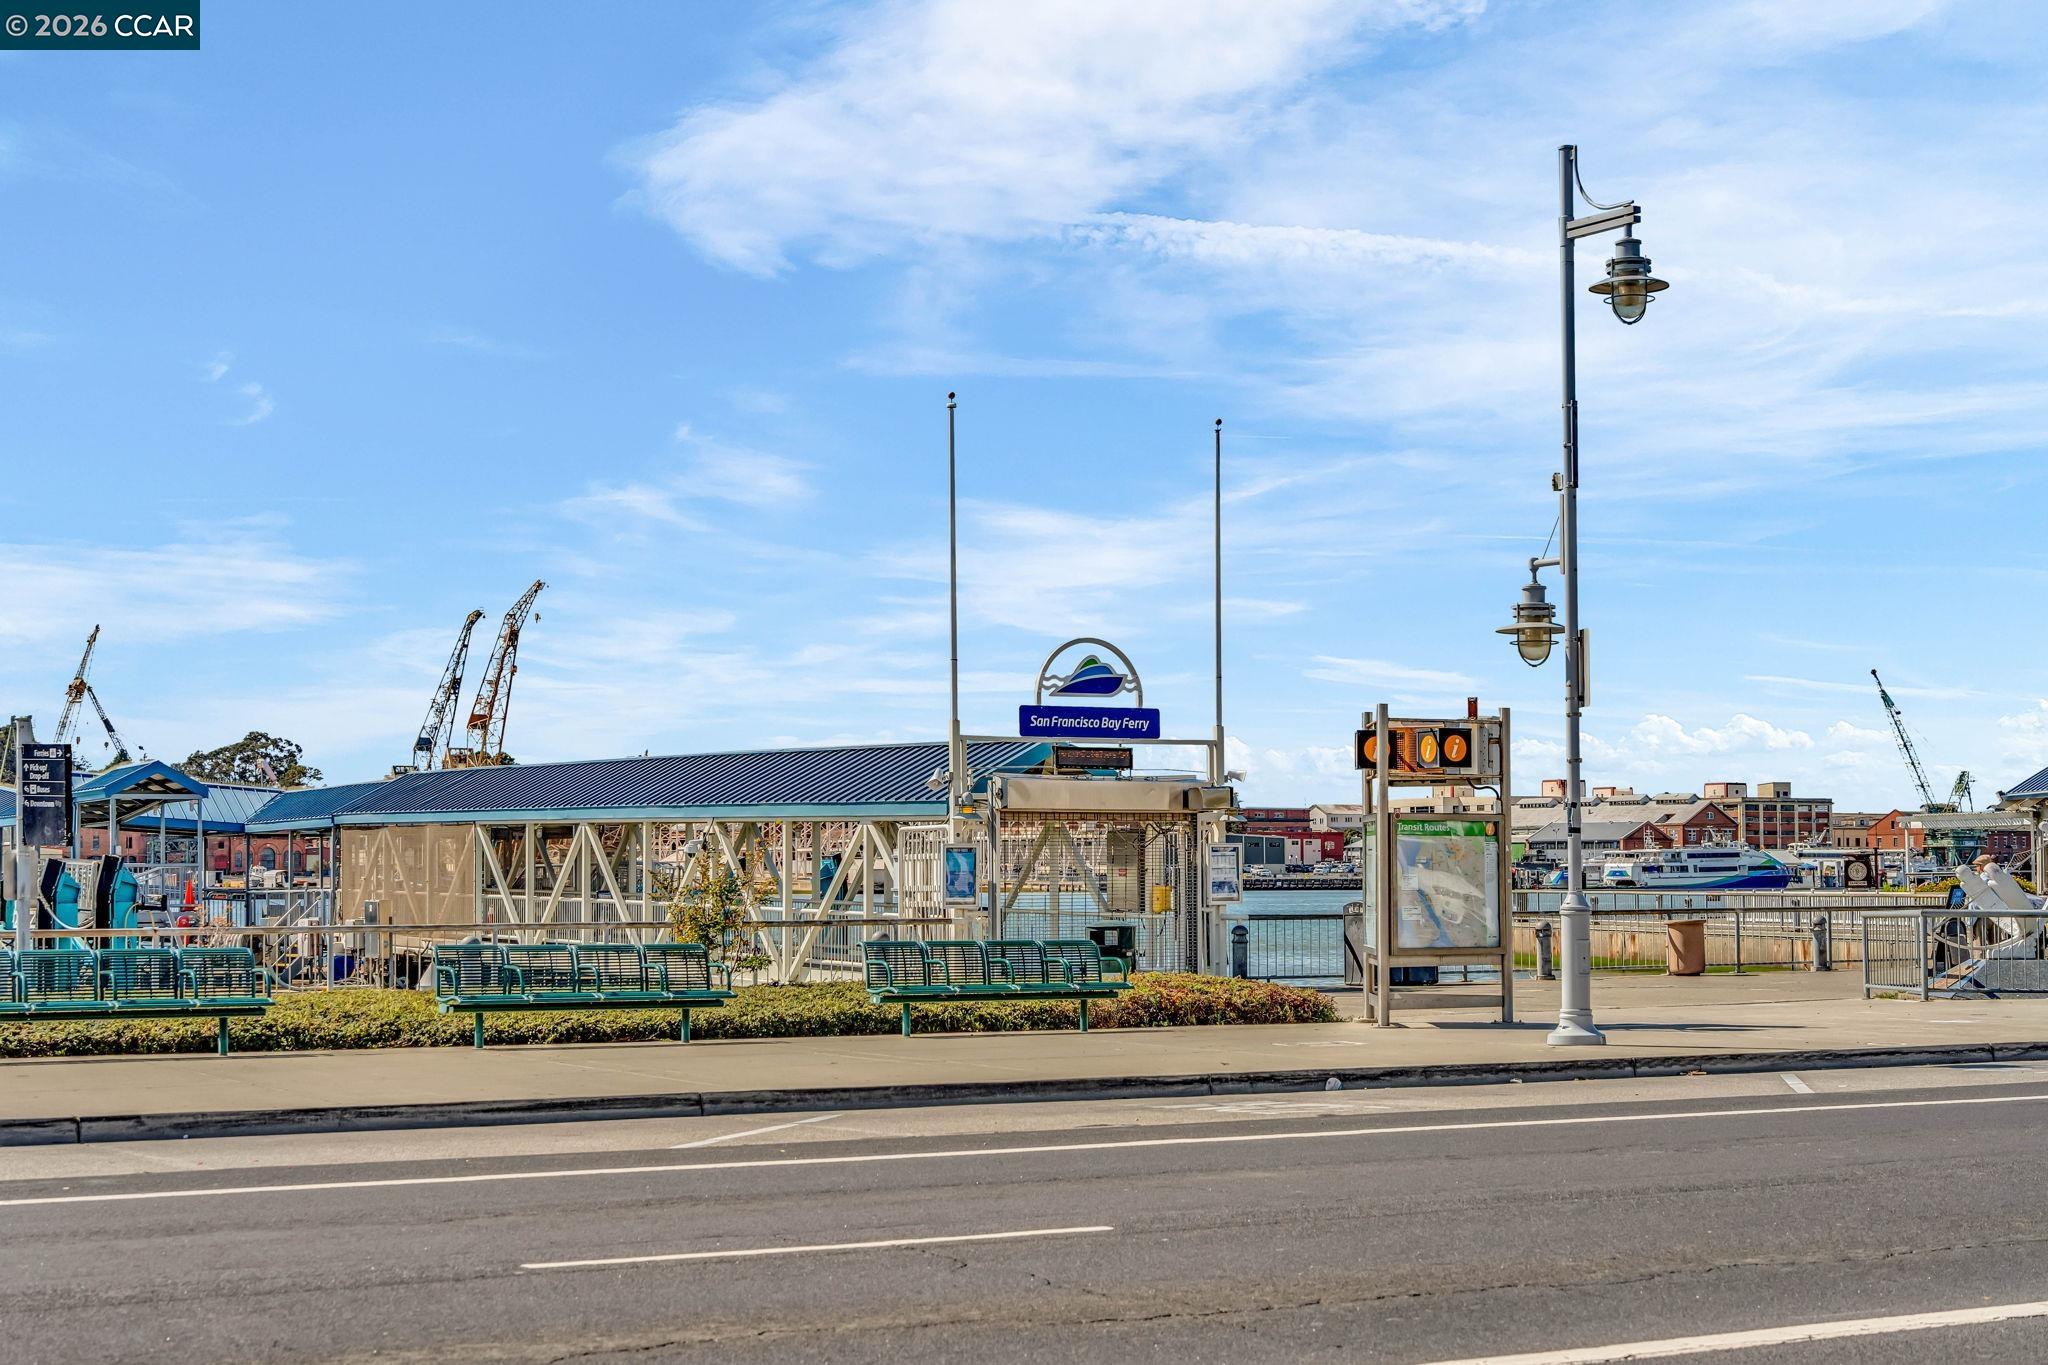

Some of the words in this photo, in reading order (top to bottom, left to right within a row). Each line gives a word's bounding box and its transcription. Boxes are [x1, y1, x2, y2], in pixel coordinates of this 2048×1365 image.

[1030, 715, 1050, 727] San
[1051, 715, 1100, 728] Francisco
[1101, 717, 1121, 731] Bay
[1122, 717, 1150, 732] Ferry
[33, 749, 50, 757] Ferries
[30, 800, 55, 808] Downtown
[1397, 822, 1423, 832] Transit
[1424, 823, 1450, 832] Routes
